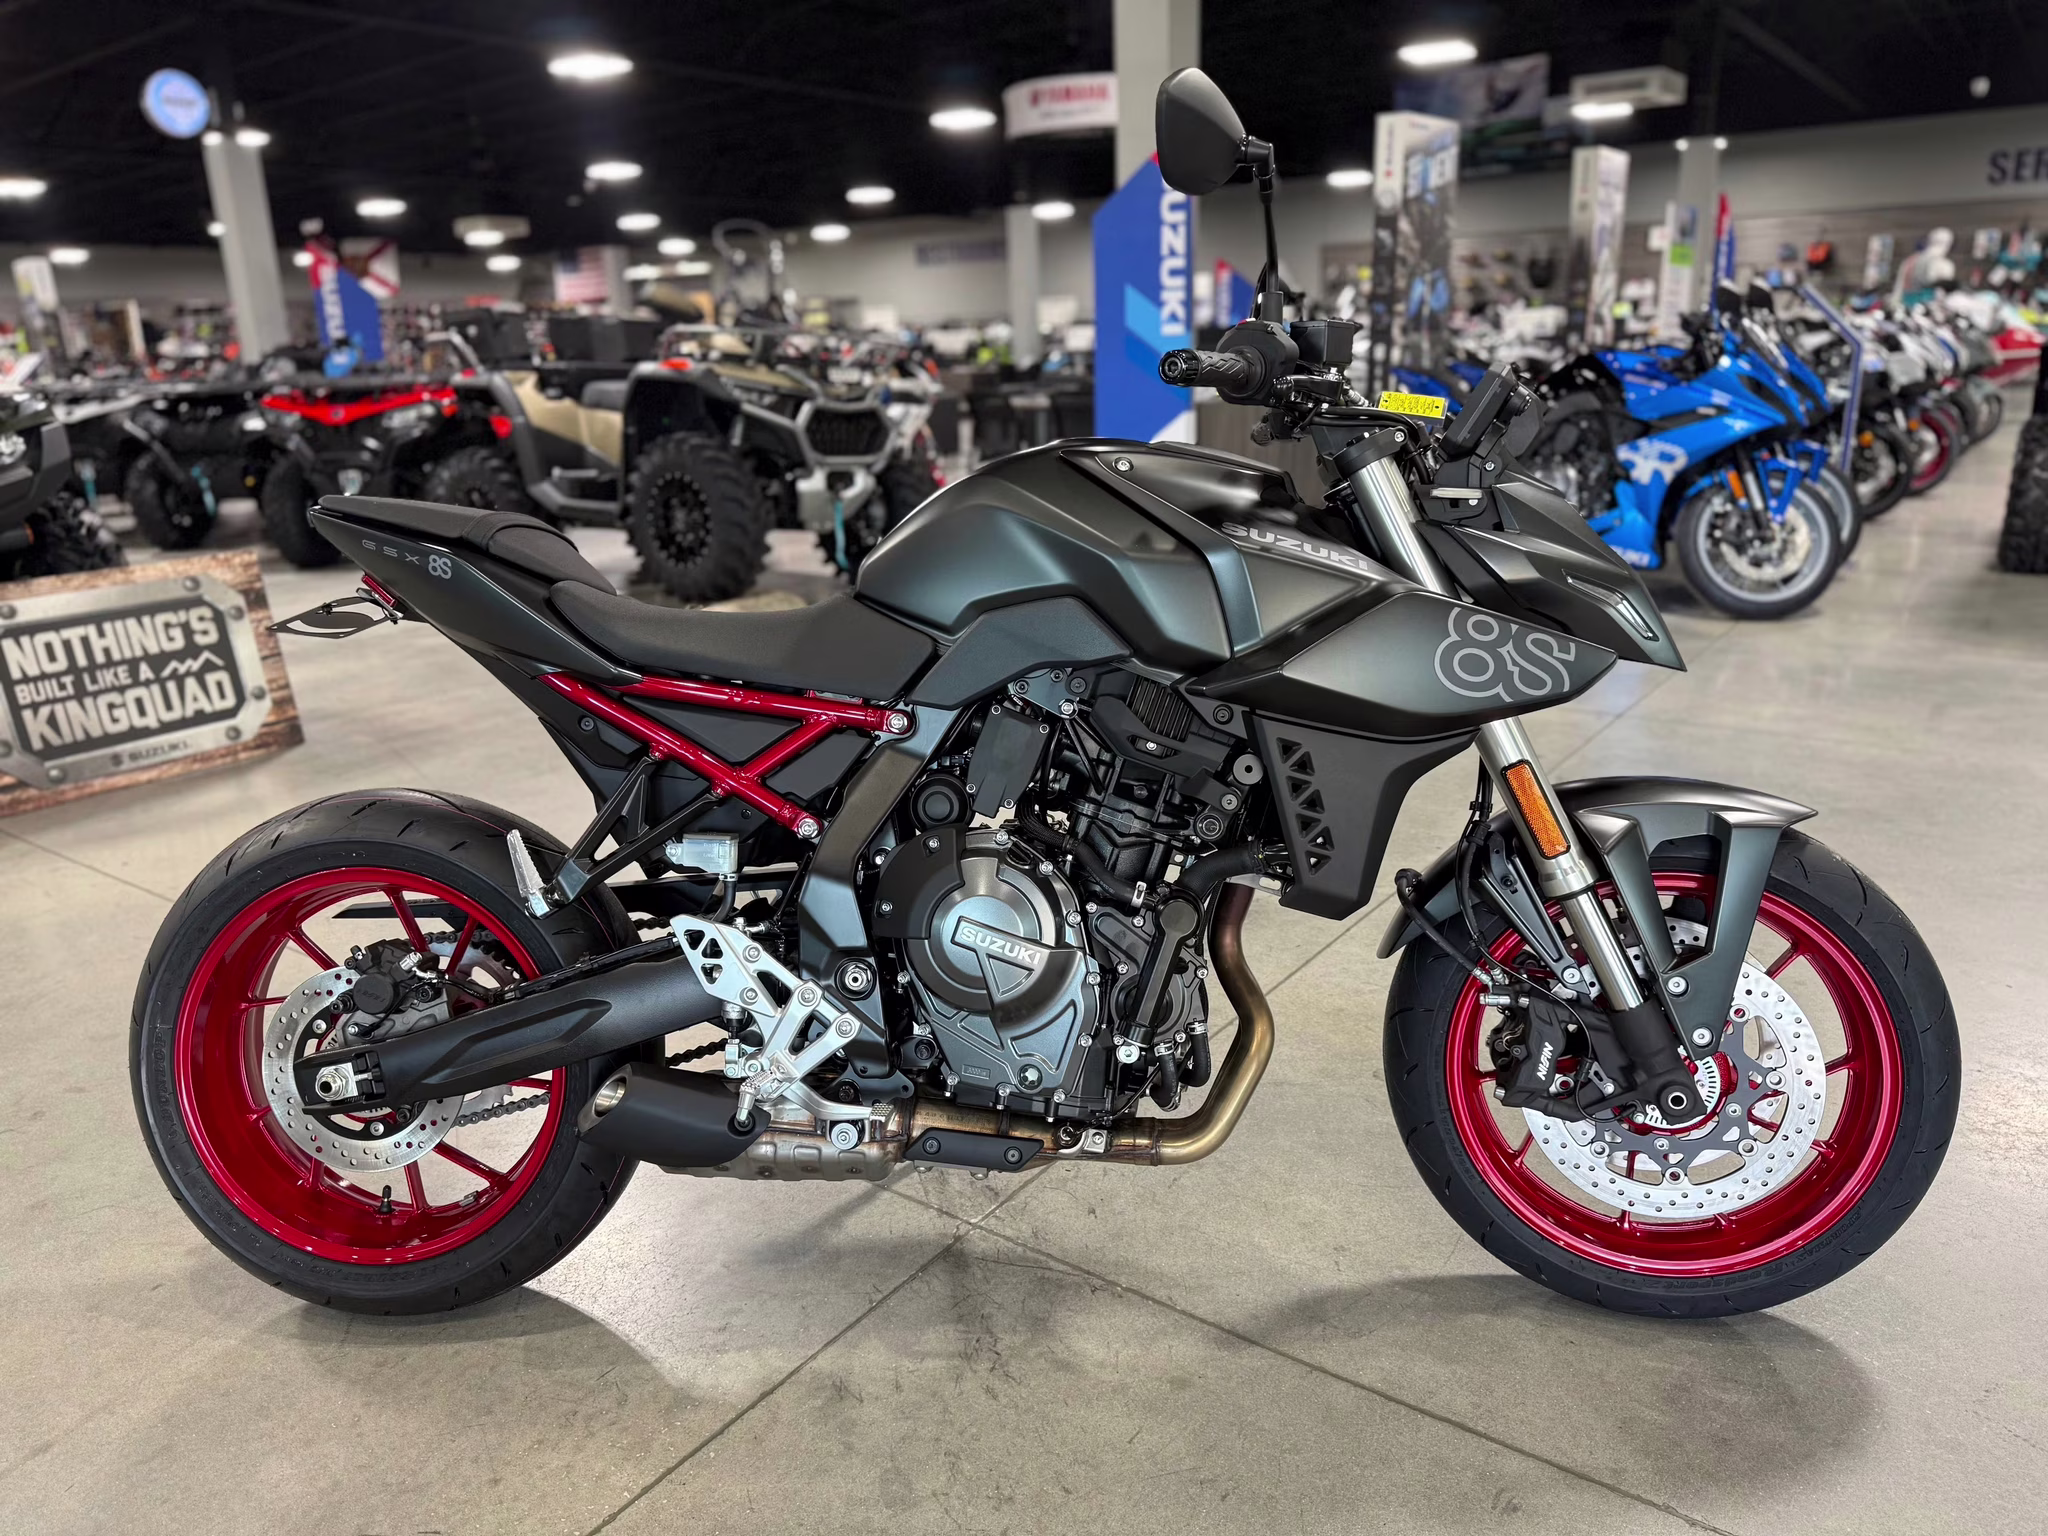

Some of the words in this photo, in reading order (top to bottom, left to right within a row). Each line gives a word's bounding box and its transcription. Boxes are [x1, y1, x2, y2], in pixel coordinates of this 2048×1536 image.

[1159, 177, 1187, 336] UZUKI
[428, 554, 452, 580] 8S
[1221, 522, 1368, 570] SUZUKI
[1, 606, 220, 680] NOTHING'S
[14, 674, 75, 706] BUILT
[83, 665, 132, 692] LIKE
[139, 661, 155, 683] A
[21, 670, 236, 751] KINGQUAD
[961, 927, 1041, 965] SUZUKI
